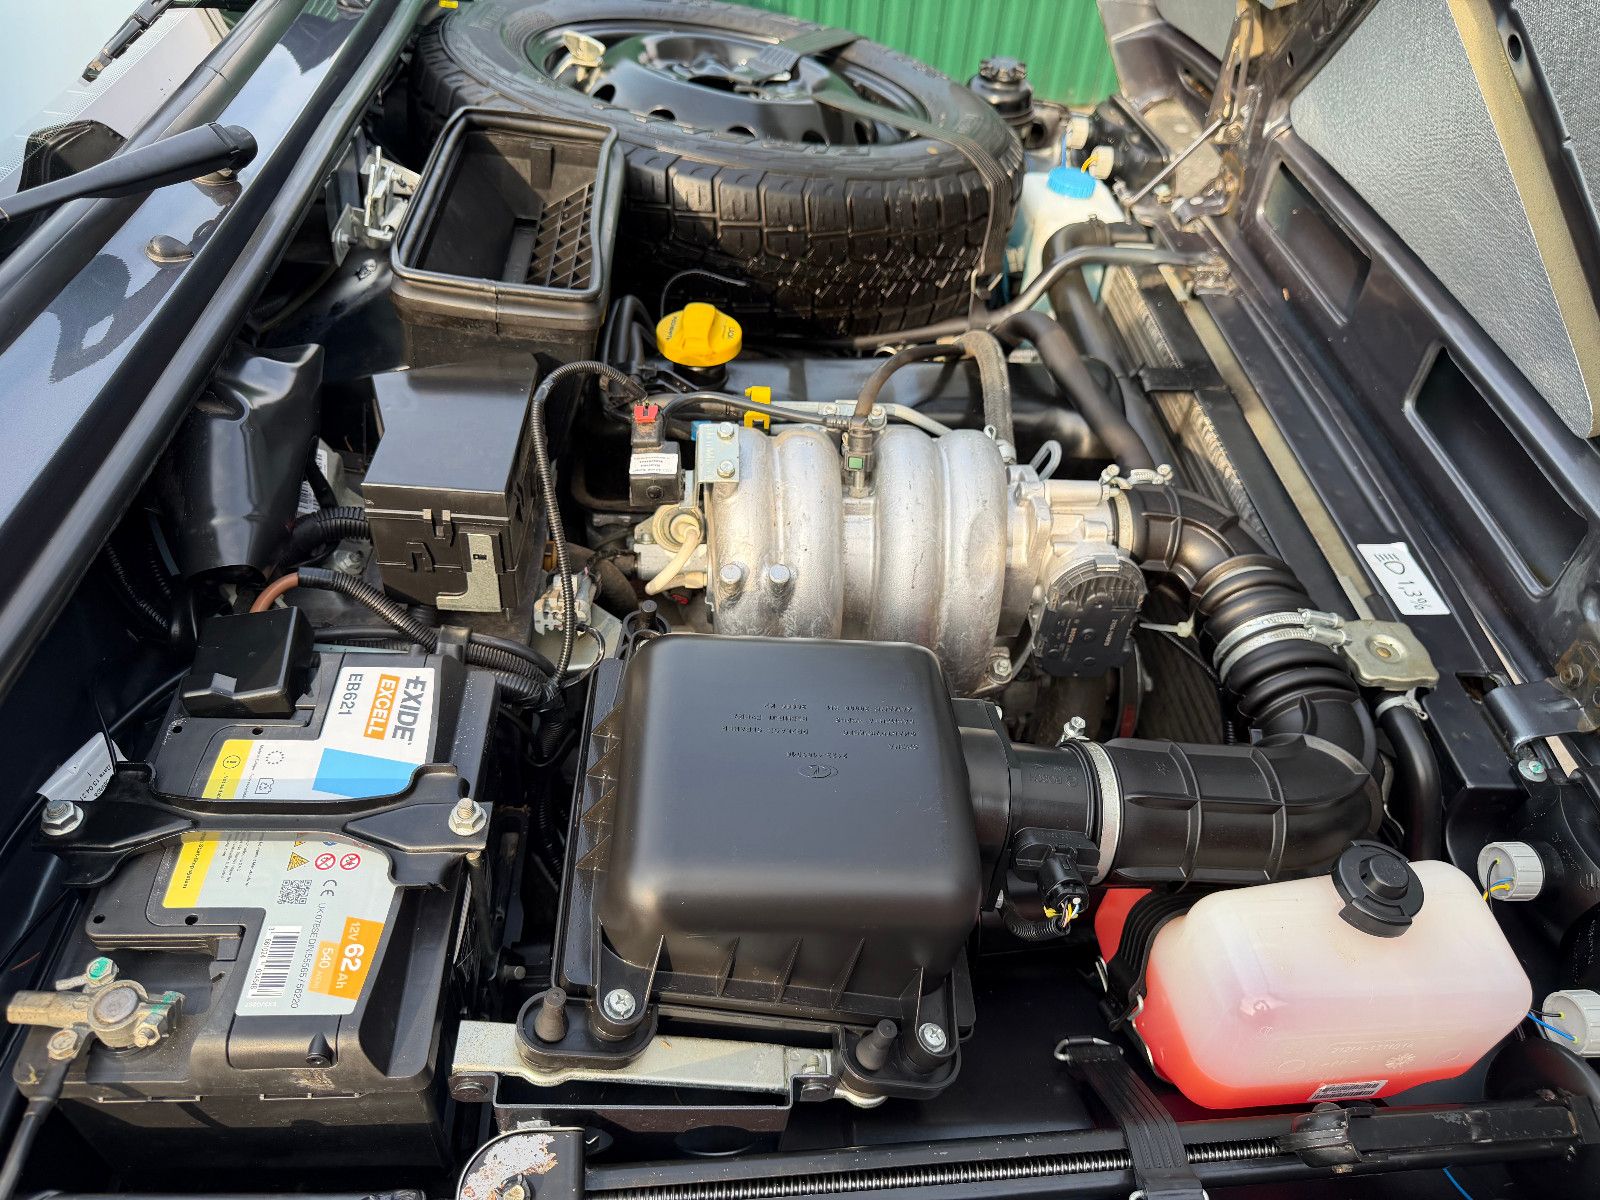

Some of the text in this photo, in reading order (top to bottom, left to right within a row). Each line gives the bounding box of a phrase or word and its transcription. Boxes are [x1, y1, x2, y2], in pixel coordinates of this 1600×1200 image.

[338, 673, 365, 716] EB621
[367, 678, 396, 735] EXCELL
[391, 675, 427, 742] EXIDE
[318, 947, 334, 969] 540
[335, 922, 364, 988] 12V 62 Ah
[290, 984, 304, 1008] 56220
